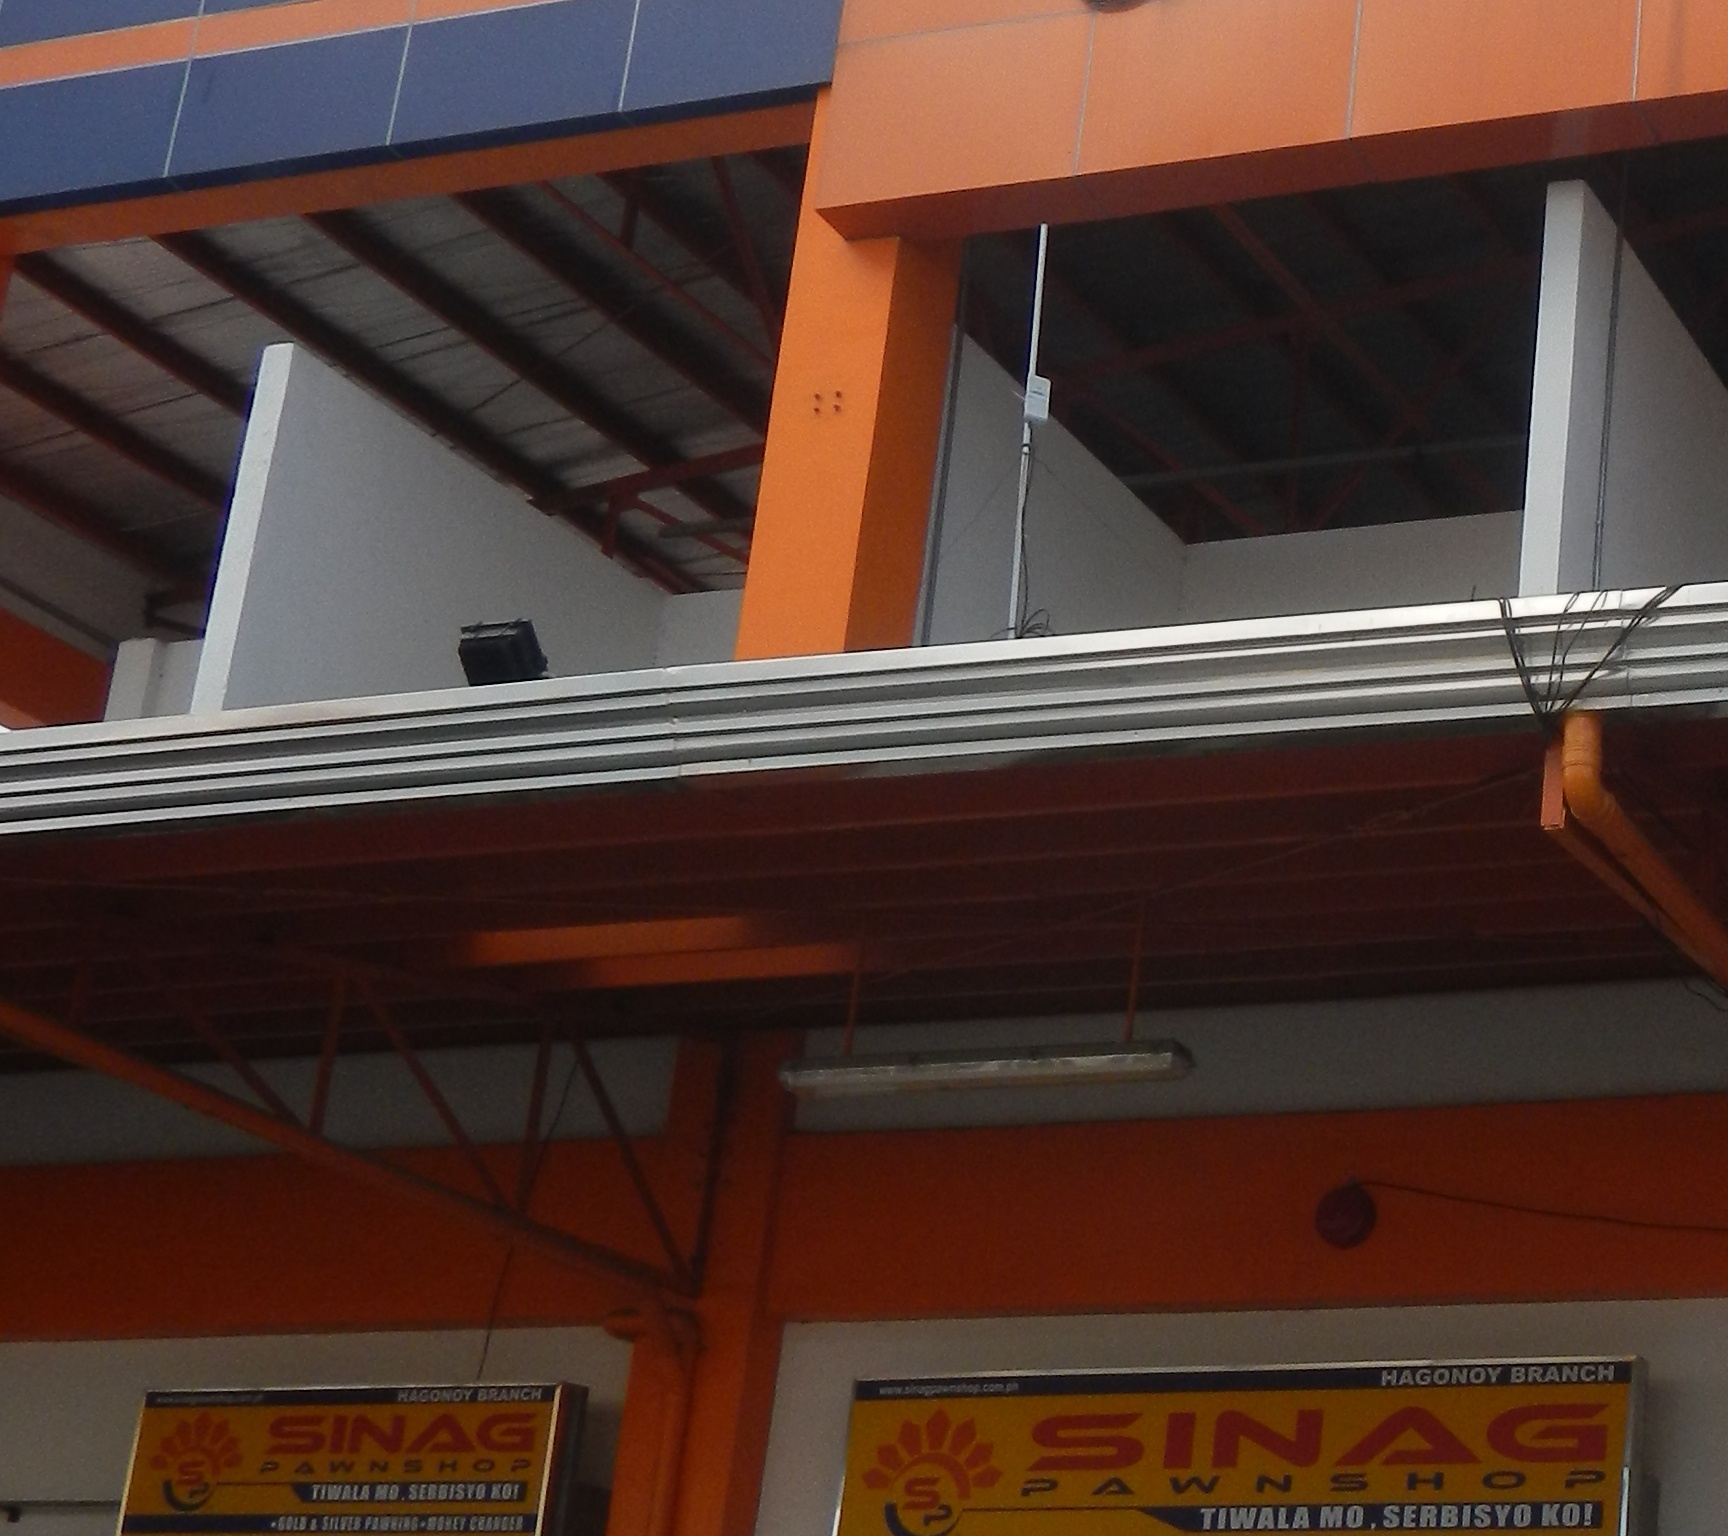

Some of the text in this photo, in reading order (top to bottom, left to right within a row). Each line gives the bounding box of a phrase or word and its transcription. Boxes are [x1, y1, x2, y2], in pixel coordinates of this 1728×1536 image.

[1381, 1364, 1615, 1387] HAGONOY BRANCH
[398, 1387, 541, 1402] HAGONOY BRANCH
[267, 1412, 535, 1454] SINAG
[1026, 1403, 1611, 1472] SINAG
[260, 1459, 532, 1474] PAWNSHOP
[311, 1482, 370, 1501] TIWALA
[1020, 1470, 1605, 1497] PAWNSHOP
[1200, 1505, 1309, 1532] TIWALA
[1382, 1504, 1532, 1528] SERBISYO
[1541, 1503, 1594, 1527] KO!
